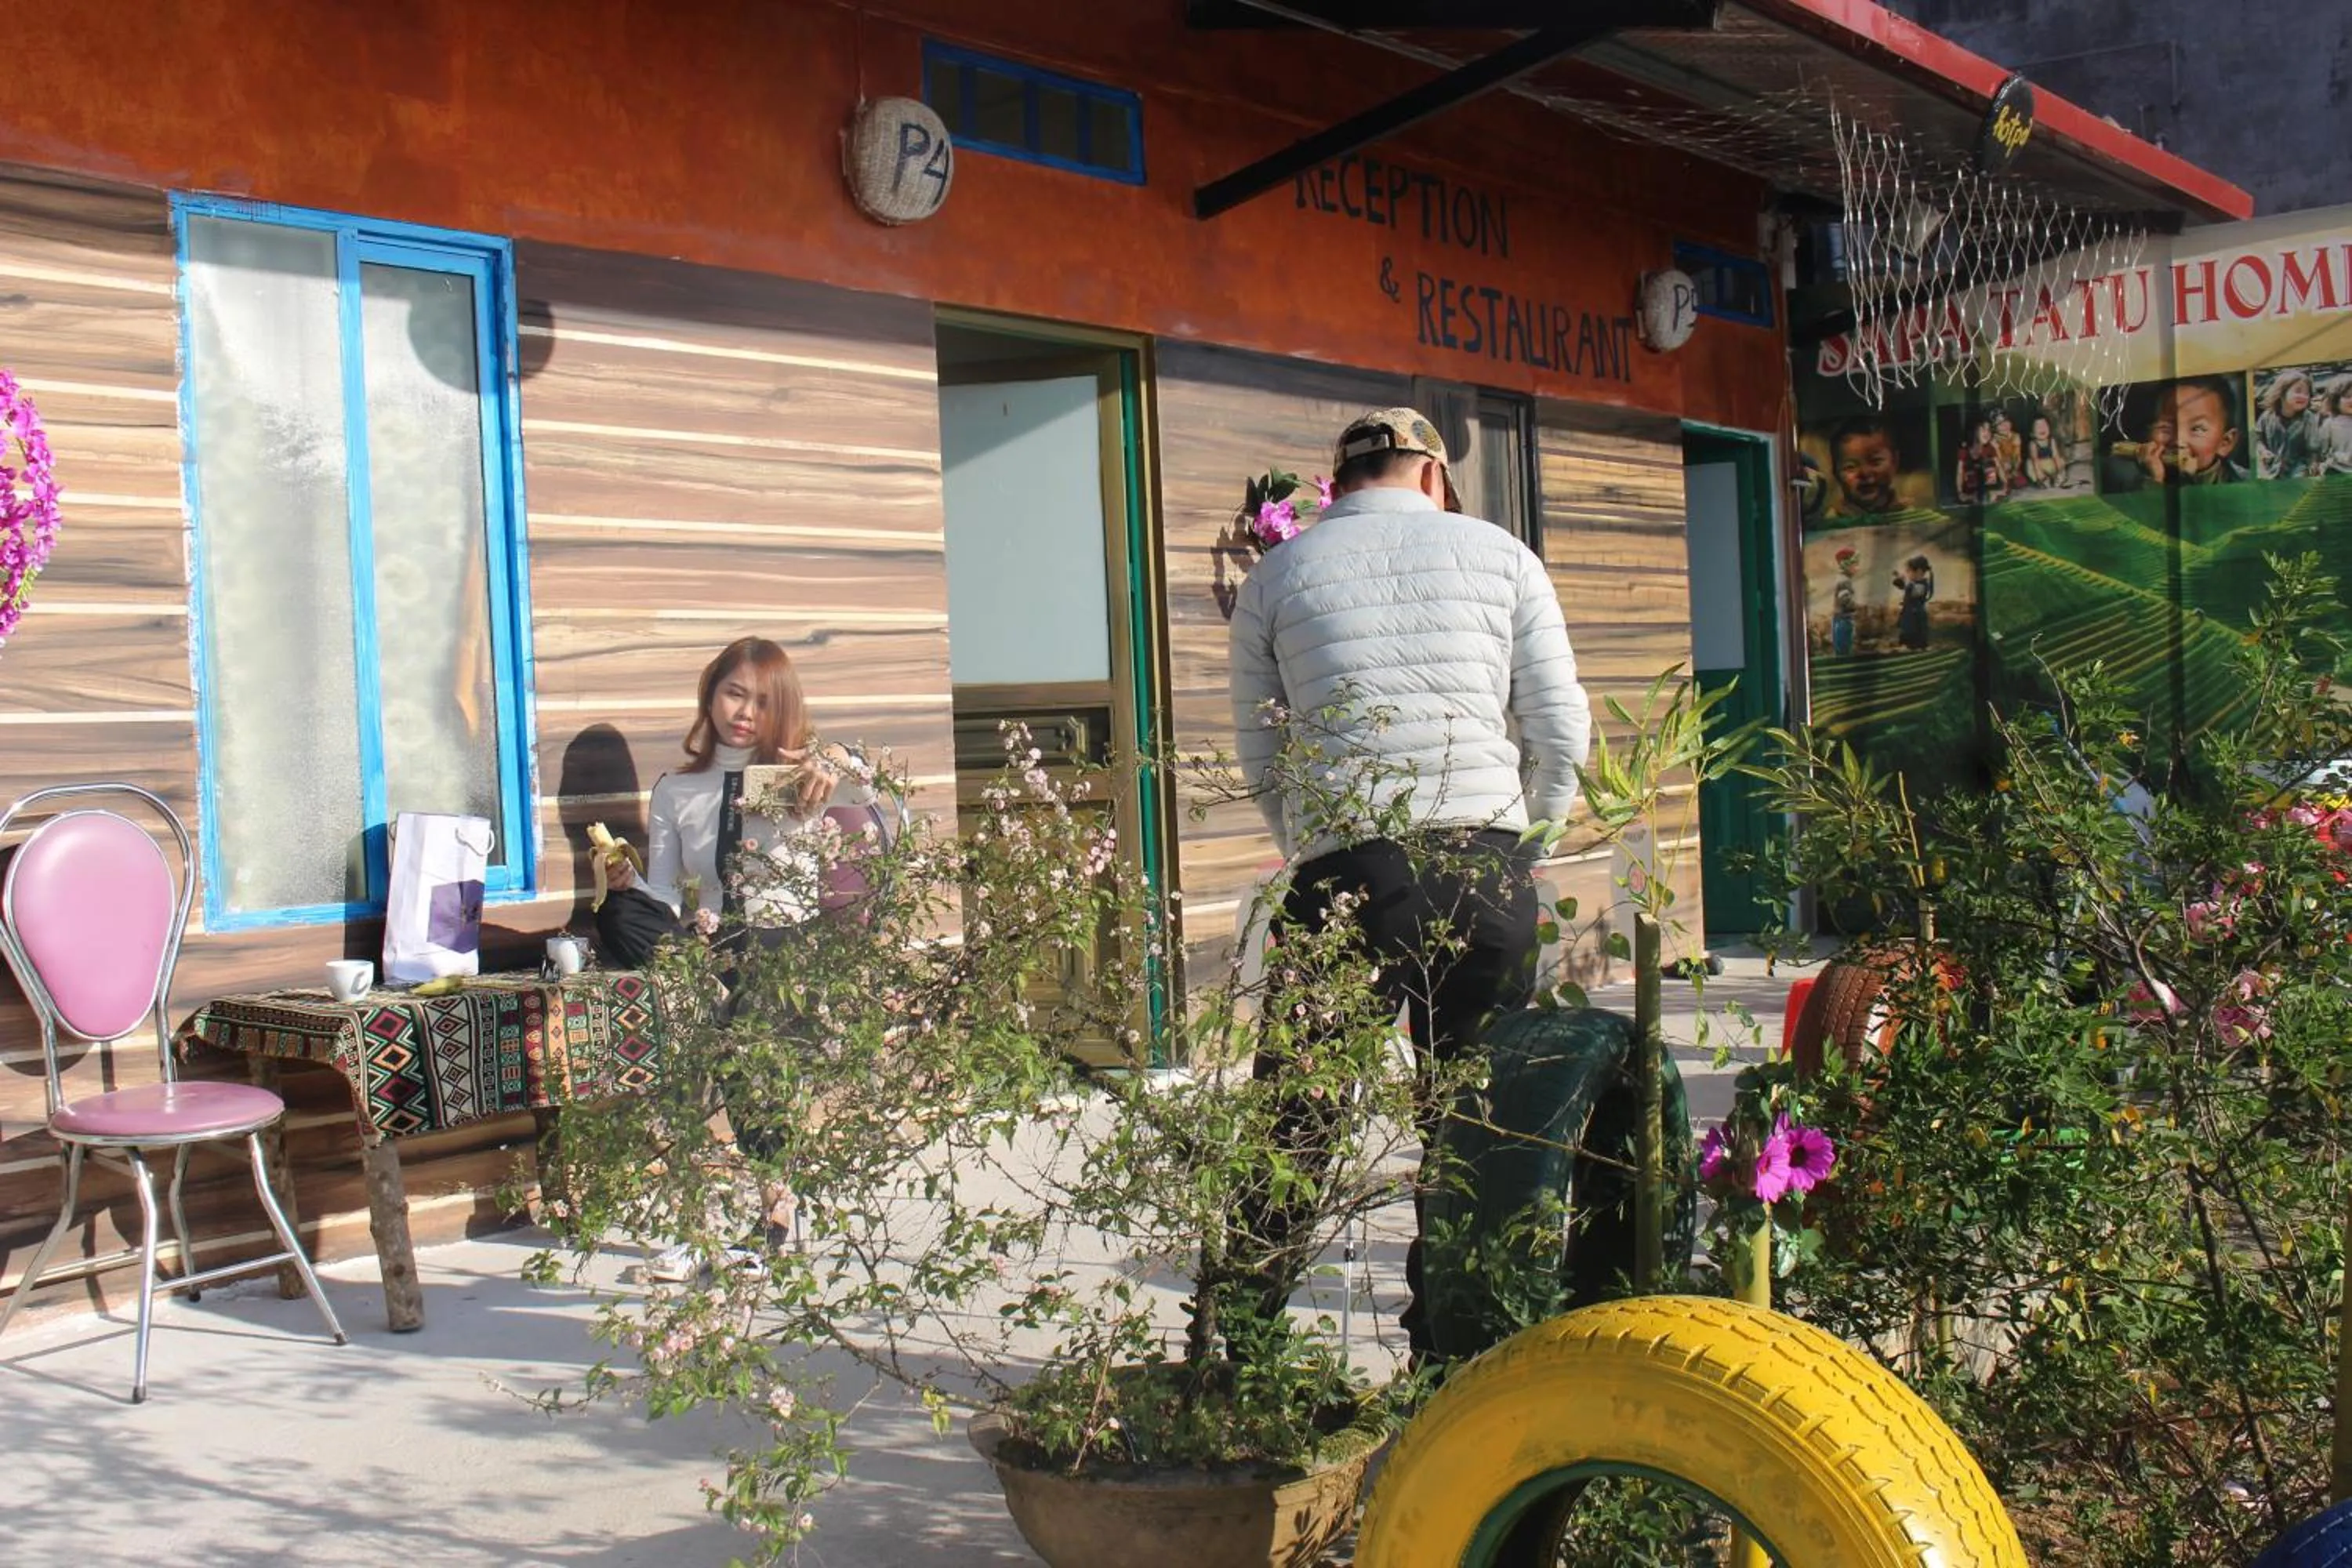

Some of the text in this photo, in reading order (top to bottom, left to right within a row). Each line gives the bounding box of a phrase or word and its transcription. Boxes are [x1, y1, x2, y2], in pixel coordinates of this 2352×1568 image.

[891, 122, 949, 207] P4
[1380, 256, 1632, 383] & RESTAURANT
[1990, 269, 2149, 348] TATU
[2169, 243, 2352, 327] HOM
